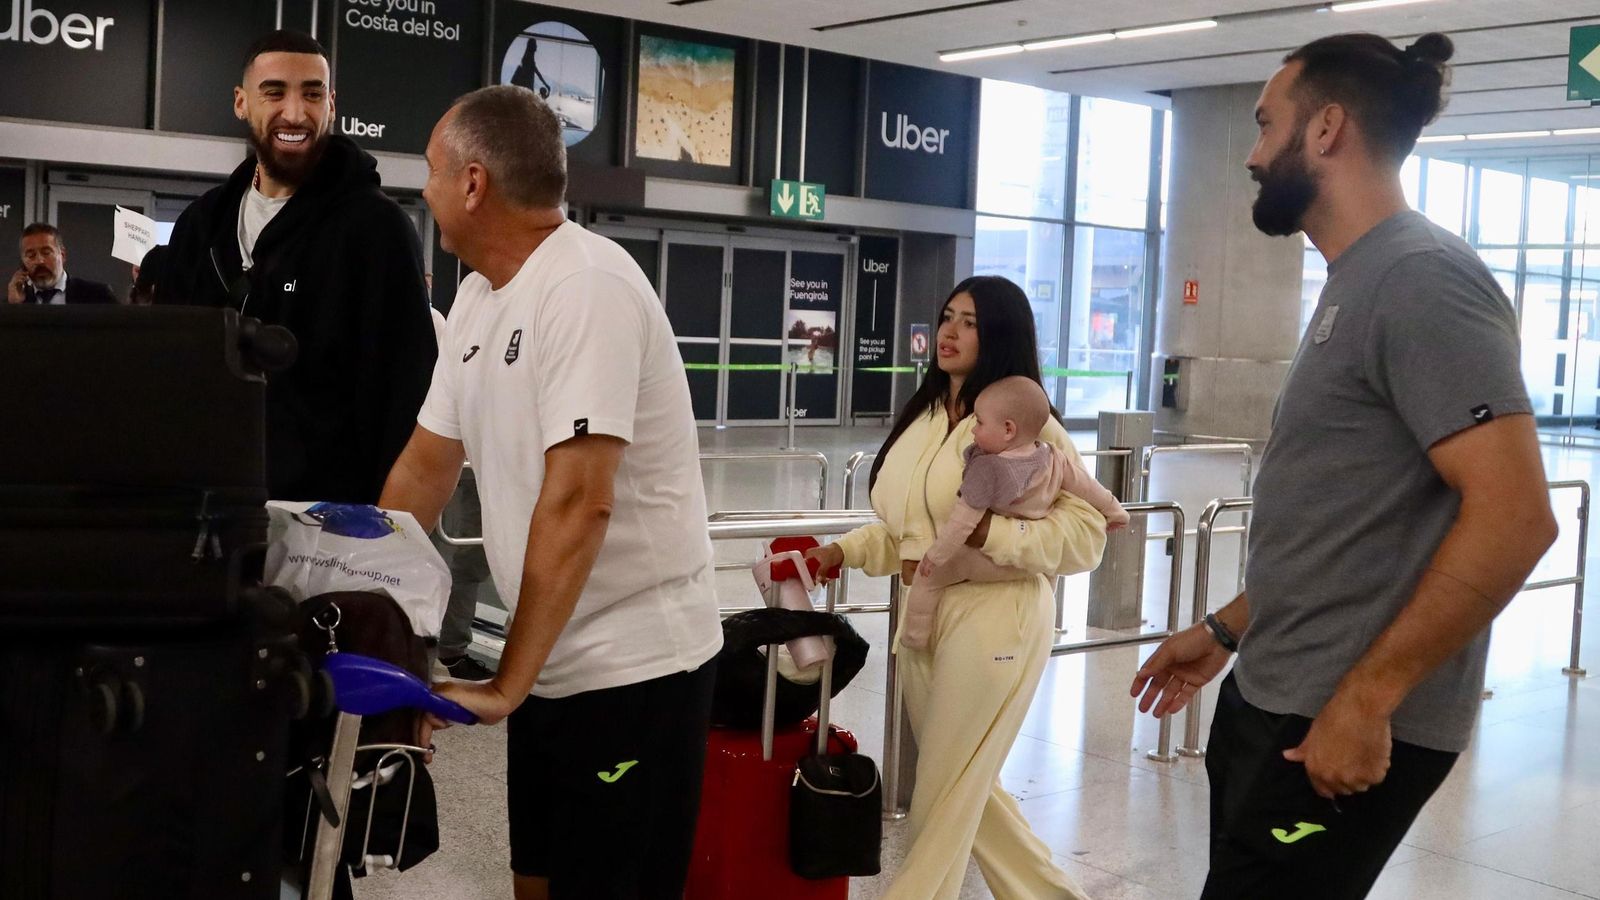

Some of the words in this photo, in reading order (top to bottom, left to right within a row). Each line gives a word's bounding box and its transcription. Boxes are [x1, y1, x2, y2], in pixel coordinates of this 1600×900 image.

[346, 9, 399, 32] Costa
[402, 17, 429, 37] del
[433, 21, 460, 41] Sol
[341, 116, 385, 137] Uber
[881, 111, 950, 155] Uber
[863, 258, 889, 273] Uber
[790, 277, 806, 289] See
[806, 280, 820, 292] you
[820, 280, 828, 289] in
[790, 290, 829, 303] Fuengirola
[858, 353, 872, 361] point
